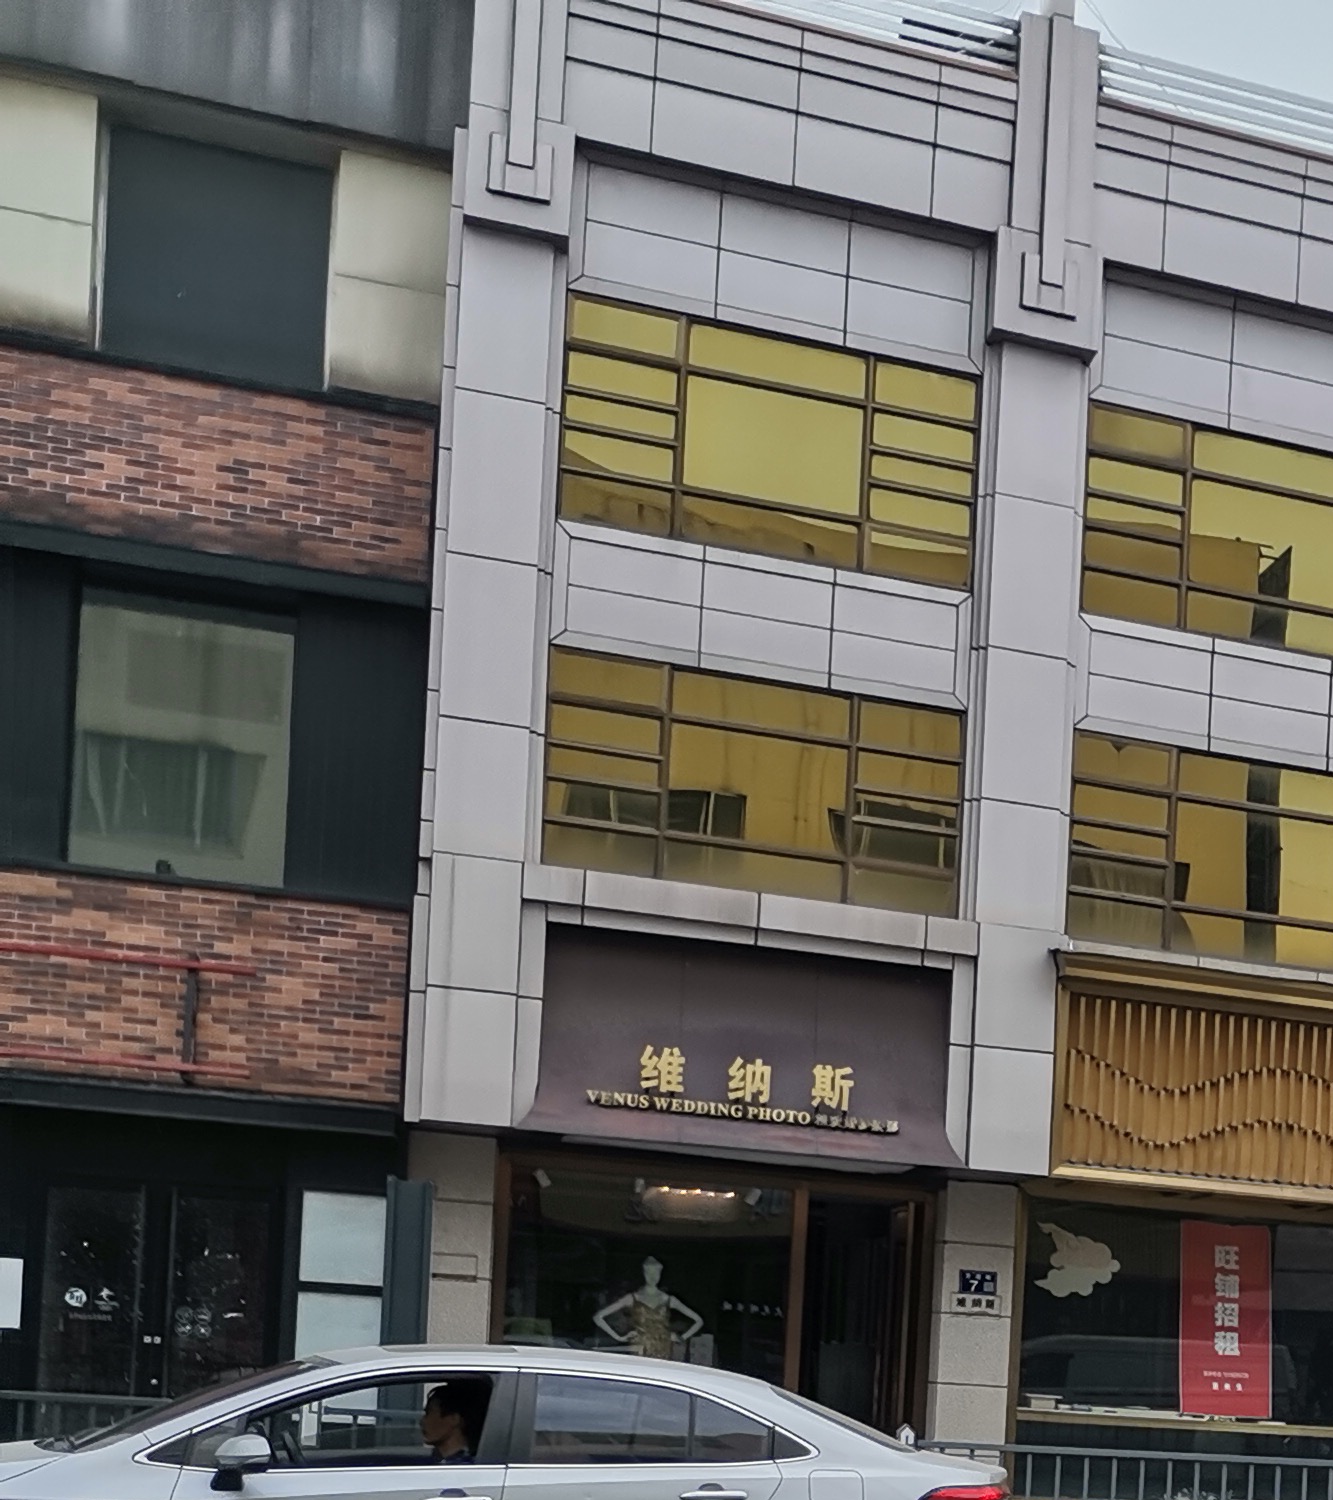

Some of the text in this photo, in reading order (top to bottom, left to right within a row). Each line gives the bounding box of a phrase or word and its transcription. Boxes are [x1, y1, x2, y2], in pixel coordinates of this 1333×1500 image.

[586, 1089, 650, 1109] VENUS
[653, 1097, 744, 1119] WEDDING
[746, 1105, 812, 1126] PHOTO
[640, 1045, 855, 1112] 维纳斯
[1213, 1244, 1241, 1357] 旺铺招租
